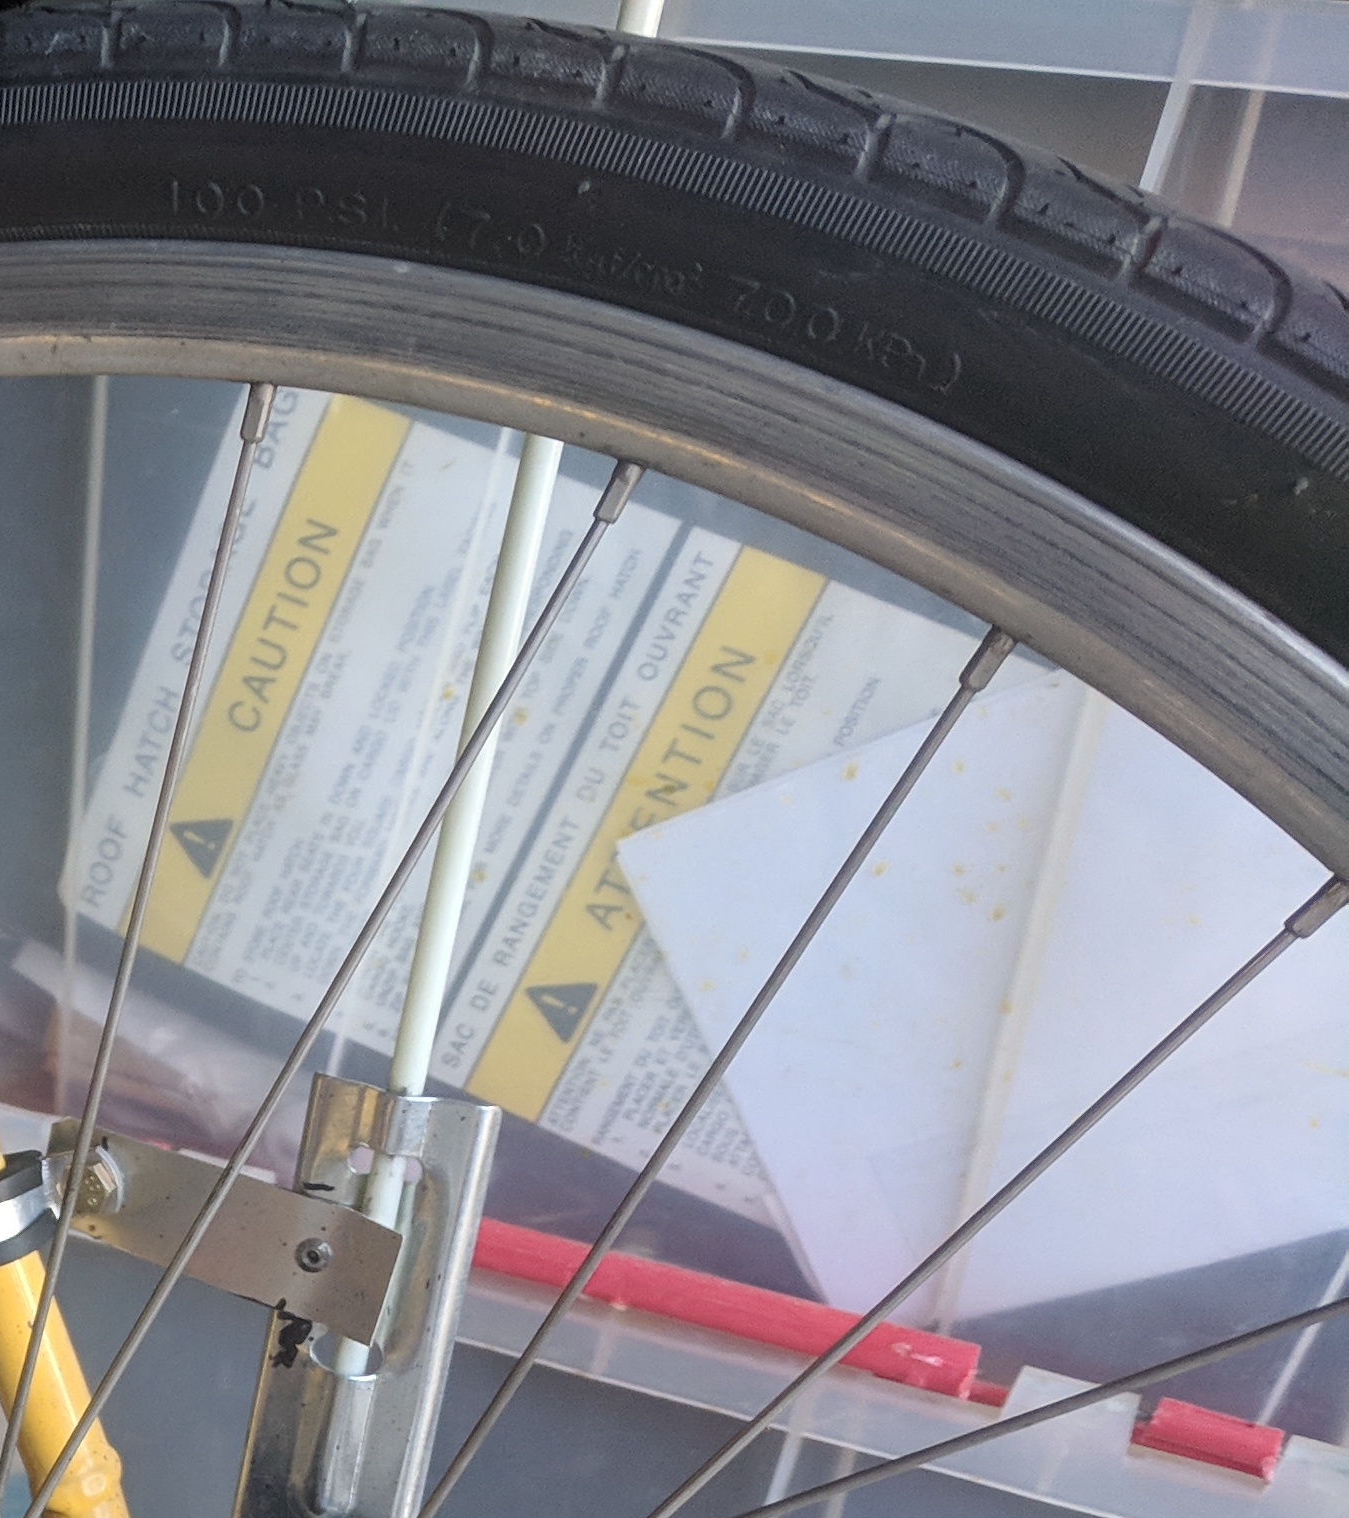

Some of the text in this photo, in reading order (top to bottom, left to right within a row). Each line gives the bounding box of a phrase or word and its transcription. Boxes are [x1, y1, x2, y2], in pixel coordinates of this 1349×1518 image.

[76, 812, 133, 909] ROOF
[119, 684, 183, 799] HATCH
[254, 388, 297, 469] BAG
[223, 516, 340, 735] CAUTION
[439, 549, 716, 1069] SAC DE RANGEMENT DU TOIT OUVRANT
[579, 642, 757, 933] ATENTION
